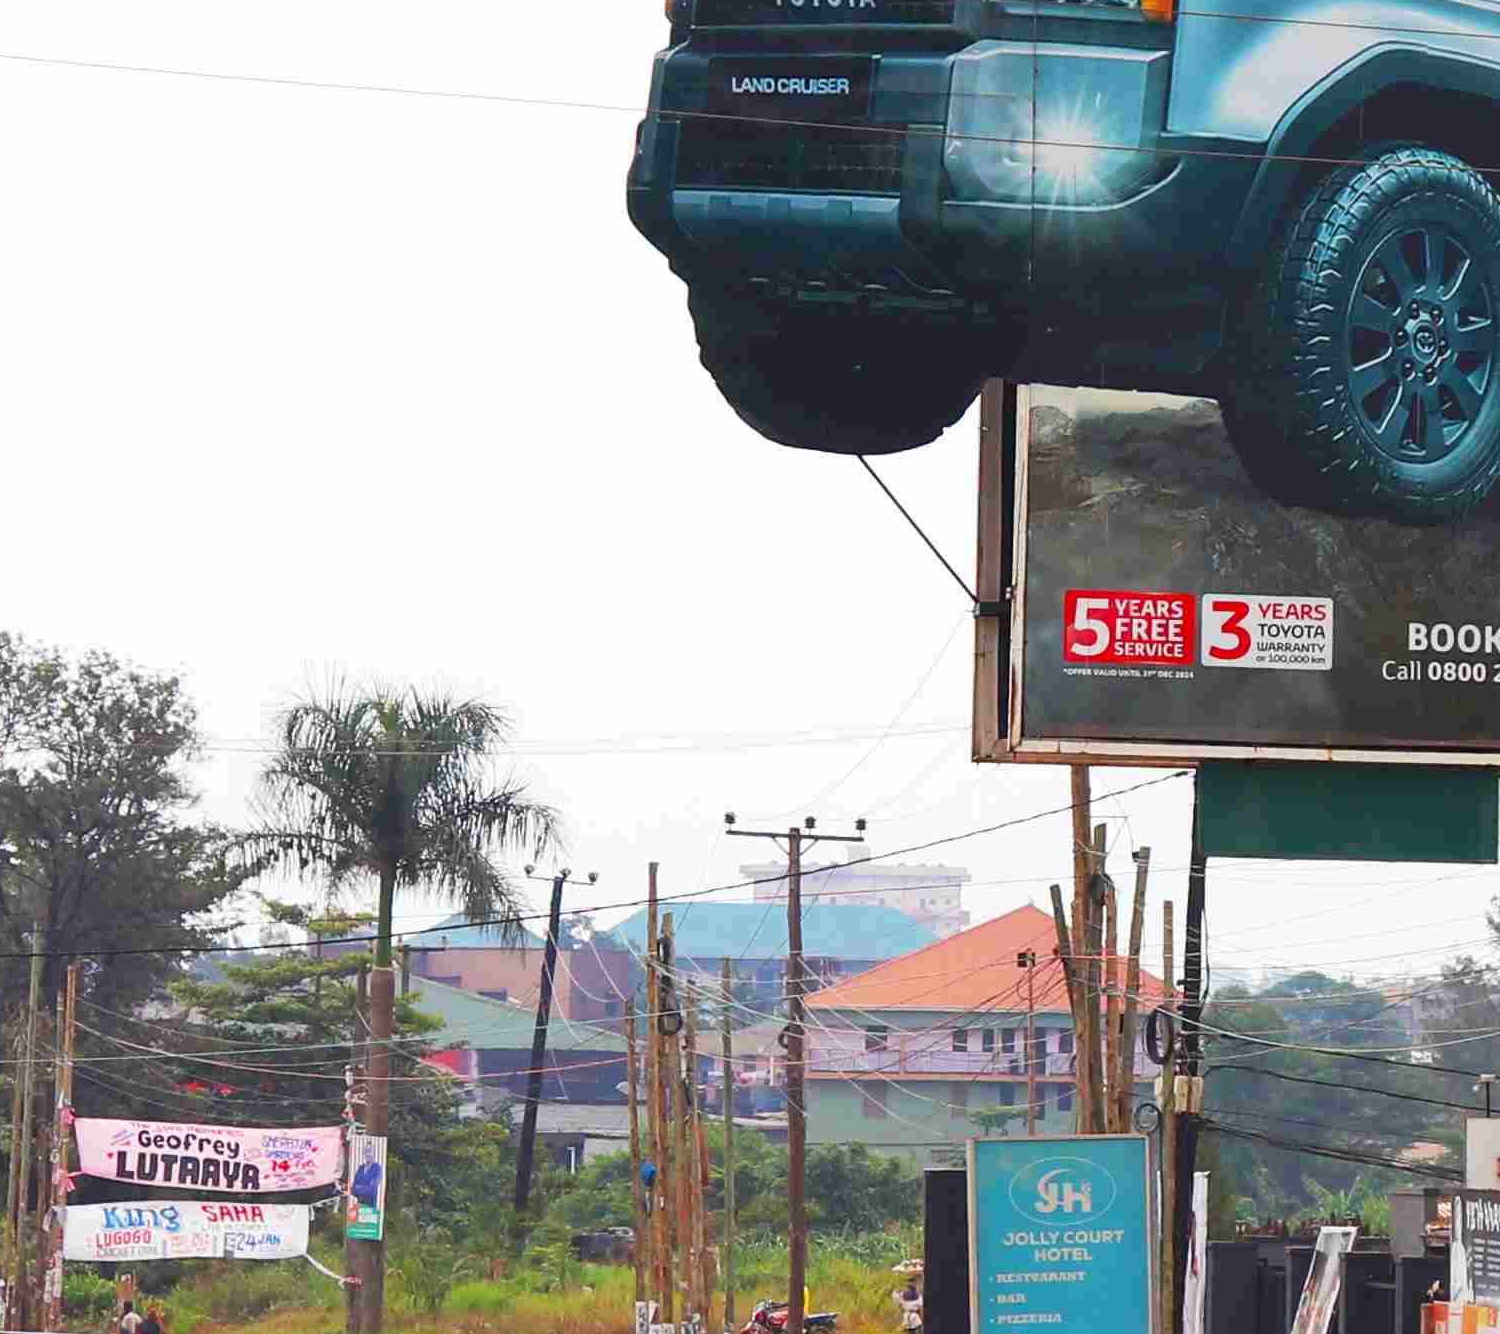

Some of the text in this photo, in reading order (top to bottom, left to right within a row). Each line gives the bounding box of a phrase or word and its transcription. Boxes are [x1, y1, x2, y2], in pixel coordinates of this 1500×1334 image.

[731, 76, 849, 95] LAND CRUISER
[1069, 597, 1184, 657] 5 YEARS
[1115, 618, 1184, 642] FREE
[1208, 600, 1326, 661] 3 YEARS
[1258, 623, 1326, 640] TOYOTA
[1113, 642, 1184, 658] SERVICE
[1256, 642, 1325, 654] WARRANTY
[1256, 654, 1326, 666] or 100,000 km
[1092, 669, 1117, 677] VALID
[1118, 670, 1142, 678] UNTIL
[1157, 671, 1174, 679] DEC
[1382, 660, 1421, 681] Call
[1427, 662, 1487, 684] 0800
[137, 1130, 241, 1159] Geofrey
[115, 1151, 261, 1190] LUTAAYA
[103, 1204, 265, 1232] King SAHA
[96, 1231, 151, 1247] LUGOGO
[1003, 1230, 1124, 1246] JOLLY COURT
[1034, 1247, 1093, 1262] HOTEL
[996, 1294, 1028, 1304] BAR
[997, 1313, 1062, 1325] PIZZERIA
